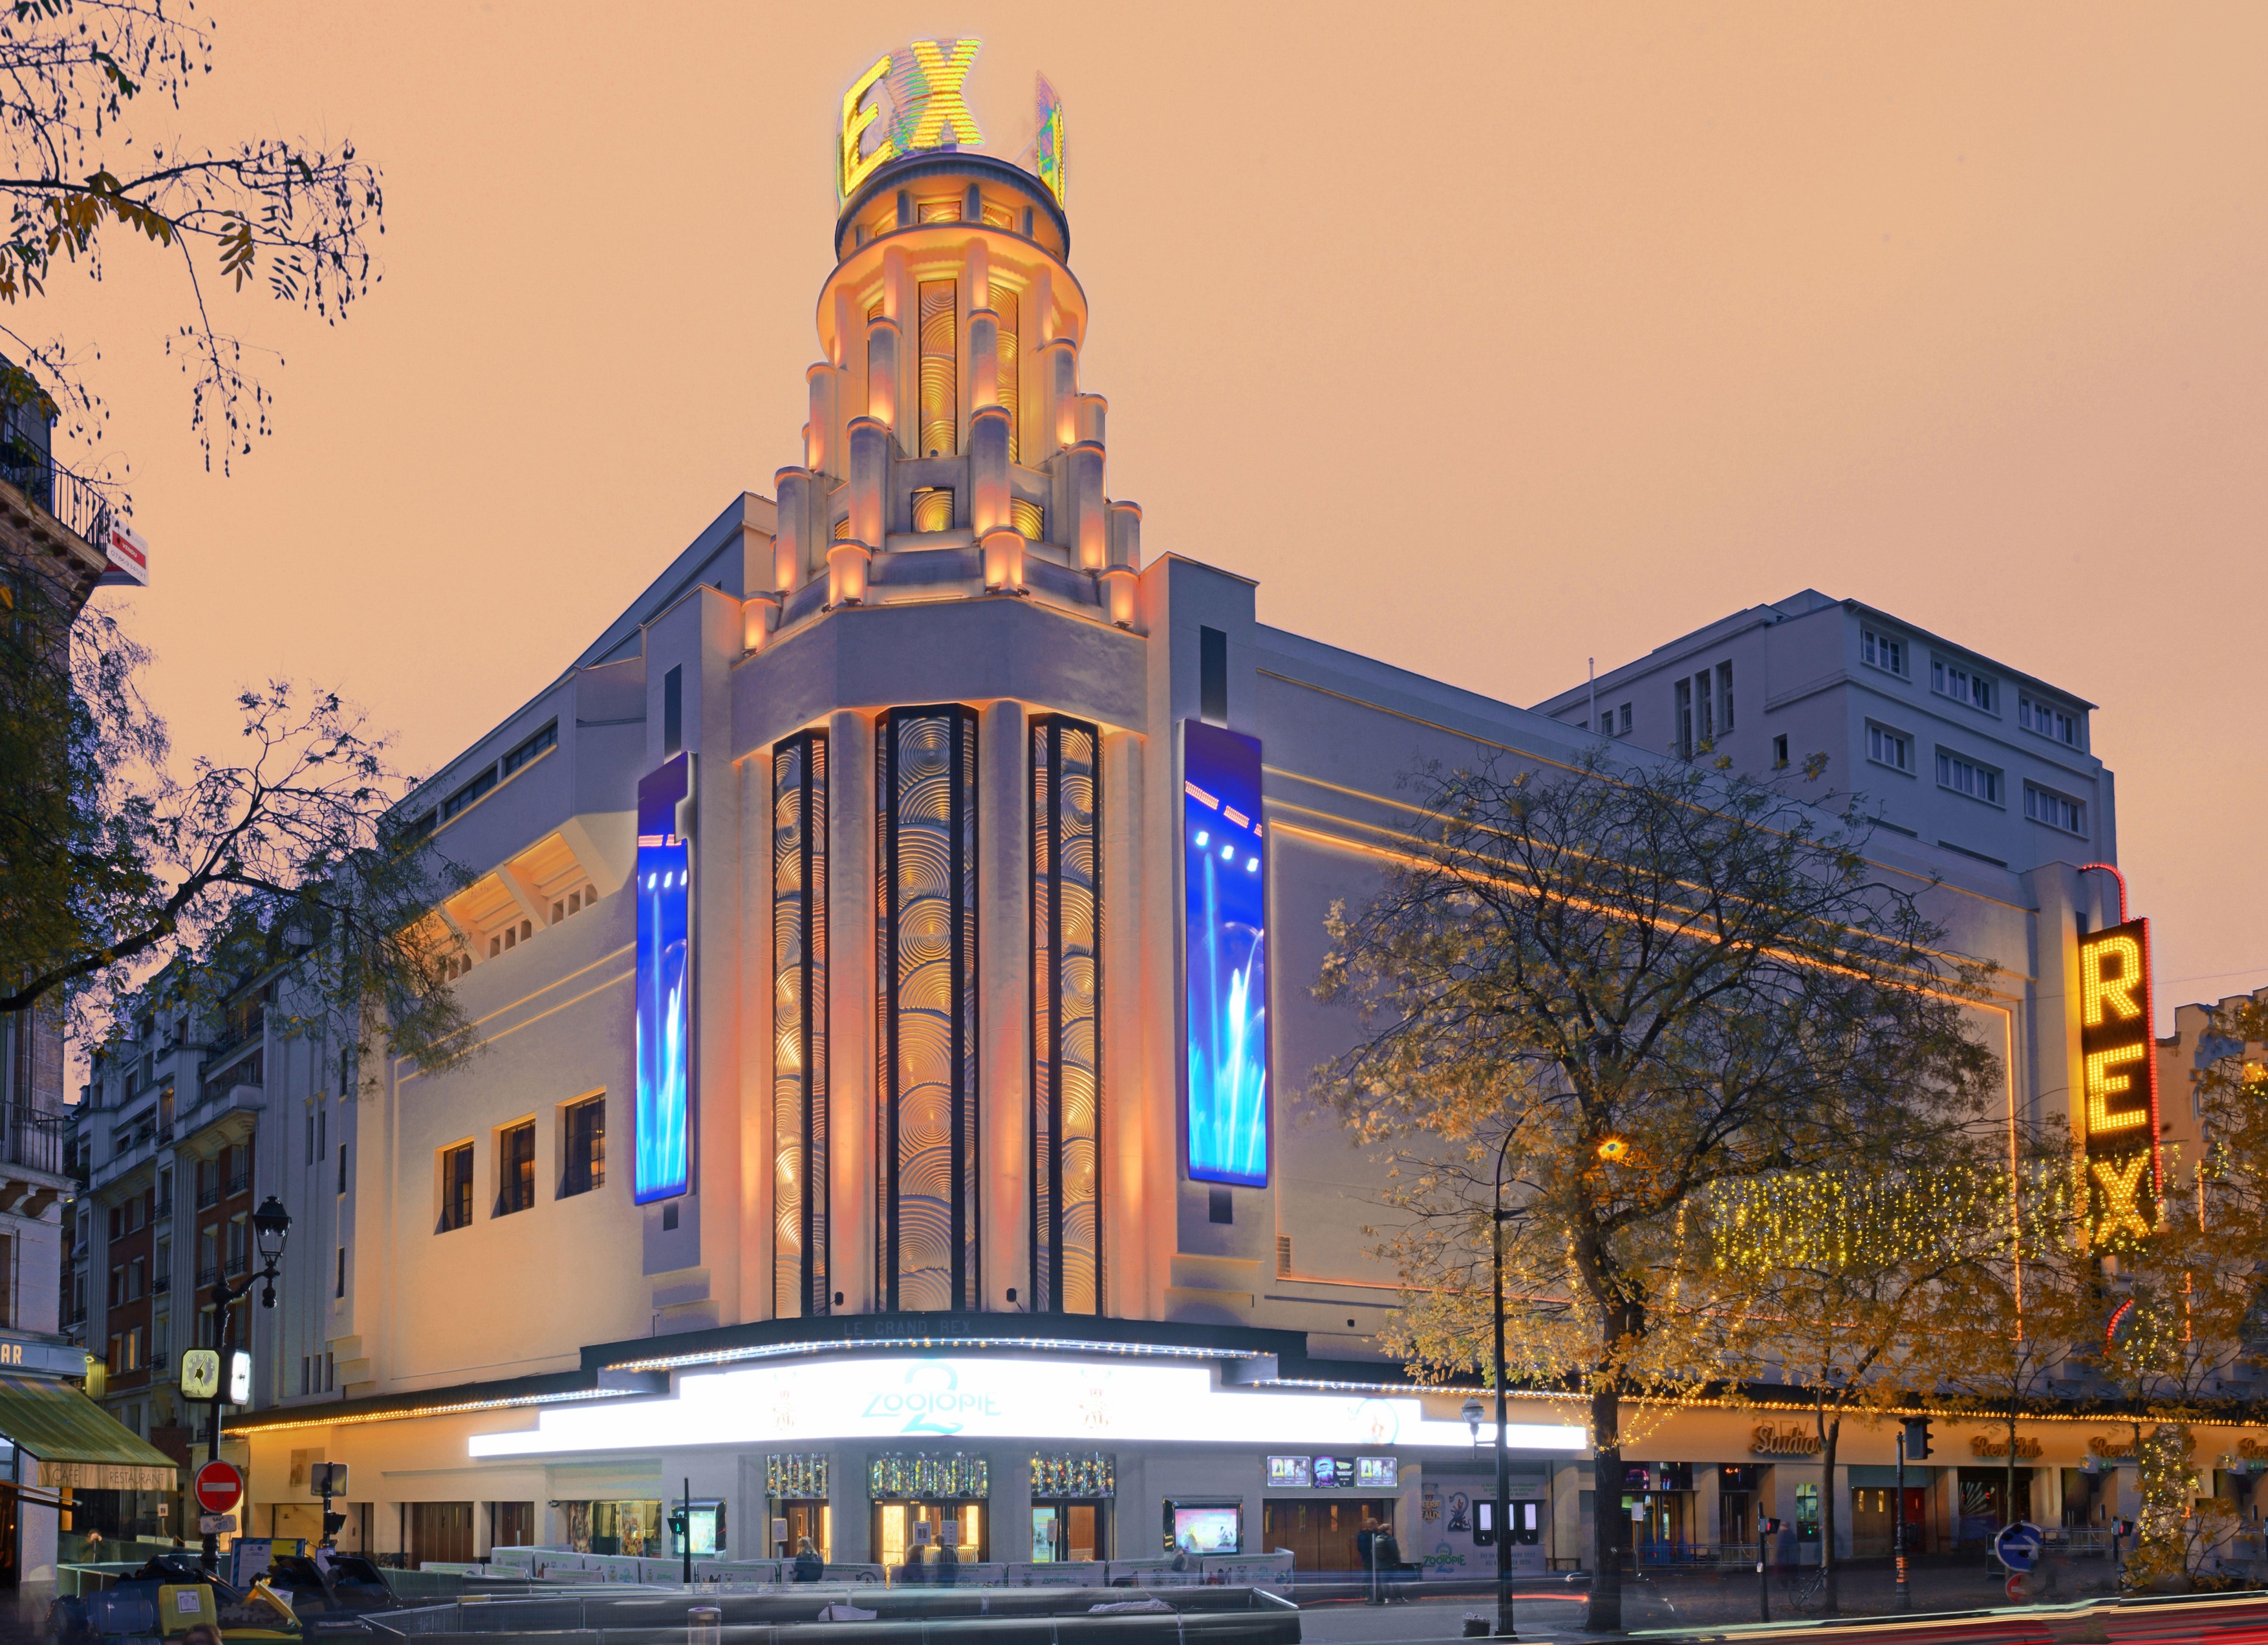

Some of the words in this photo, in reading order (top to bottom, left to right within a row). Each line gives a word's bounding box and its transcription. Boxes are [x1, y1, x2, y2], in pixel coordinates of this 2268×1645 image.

[122, 543, 138, 558] VENDU
[2081, 936, 2151, 1243] REX
[843, 1322, 864, 1337] LE
[874, 1320, 928, 1335] GRAND
[940, 1319, 971, 1335] REX
[860, 1390, 1002, 1418] ZOOTOPIE
[109, 1471, 165, 1485] RESTAURANT
[1423, 1554, 1466, 1568] ZOOTOPIE
